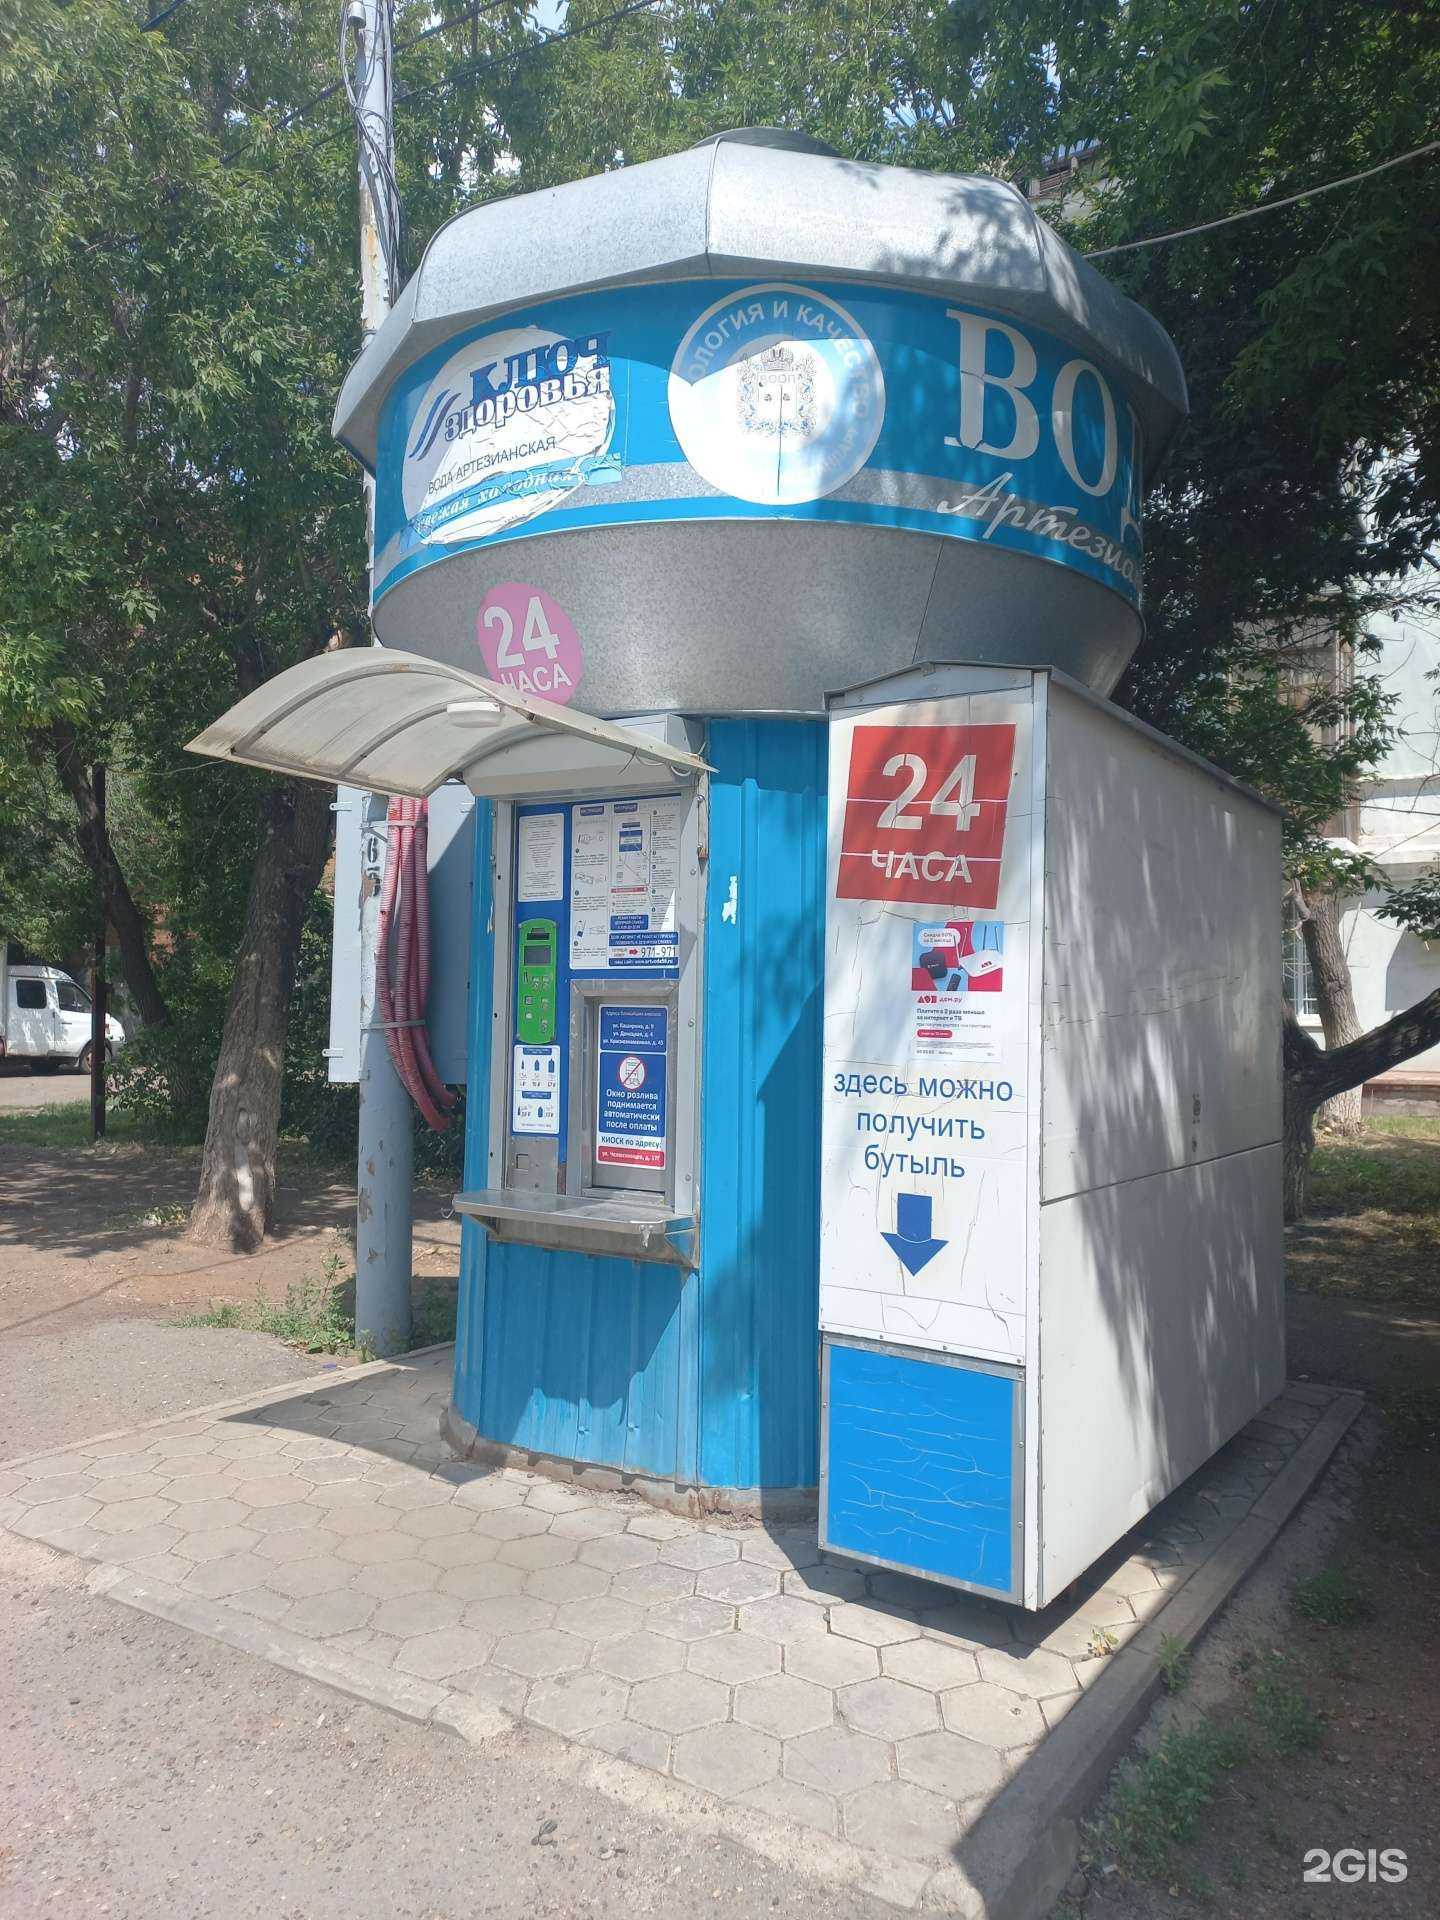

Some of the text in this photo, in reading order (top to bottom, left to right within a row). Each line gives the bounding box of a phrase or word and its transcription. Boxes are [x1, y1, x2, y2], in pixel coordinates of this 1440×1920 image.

[773, 301, 788, 317] И
[470, 331, 612, 402] КЛЮЧ
[427, 436, 557, 495] ВОДА АРТЕЗИАНСКАЯ
[484, 596, 560, 668] 24
[877, 753, 981, 831] 24
[871, 850, 973, 884] ЧАСА
[641, 946, 676, 958] 971-971
[606, 1088, 658, 1100] Окно розлива
[834, 1073, 1013, 1102] здесь можно
[604, 1110, 660, 1121] автоматически
[607, 1100, 657, 1111] поднимается
[601, 1136, 624, 1145] КИОСК
[606, 1120, 657, 1132] после оплаты
[857, 1112, 986, 1141] получить
[864, 1144, 965, 1178] бутыль
